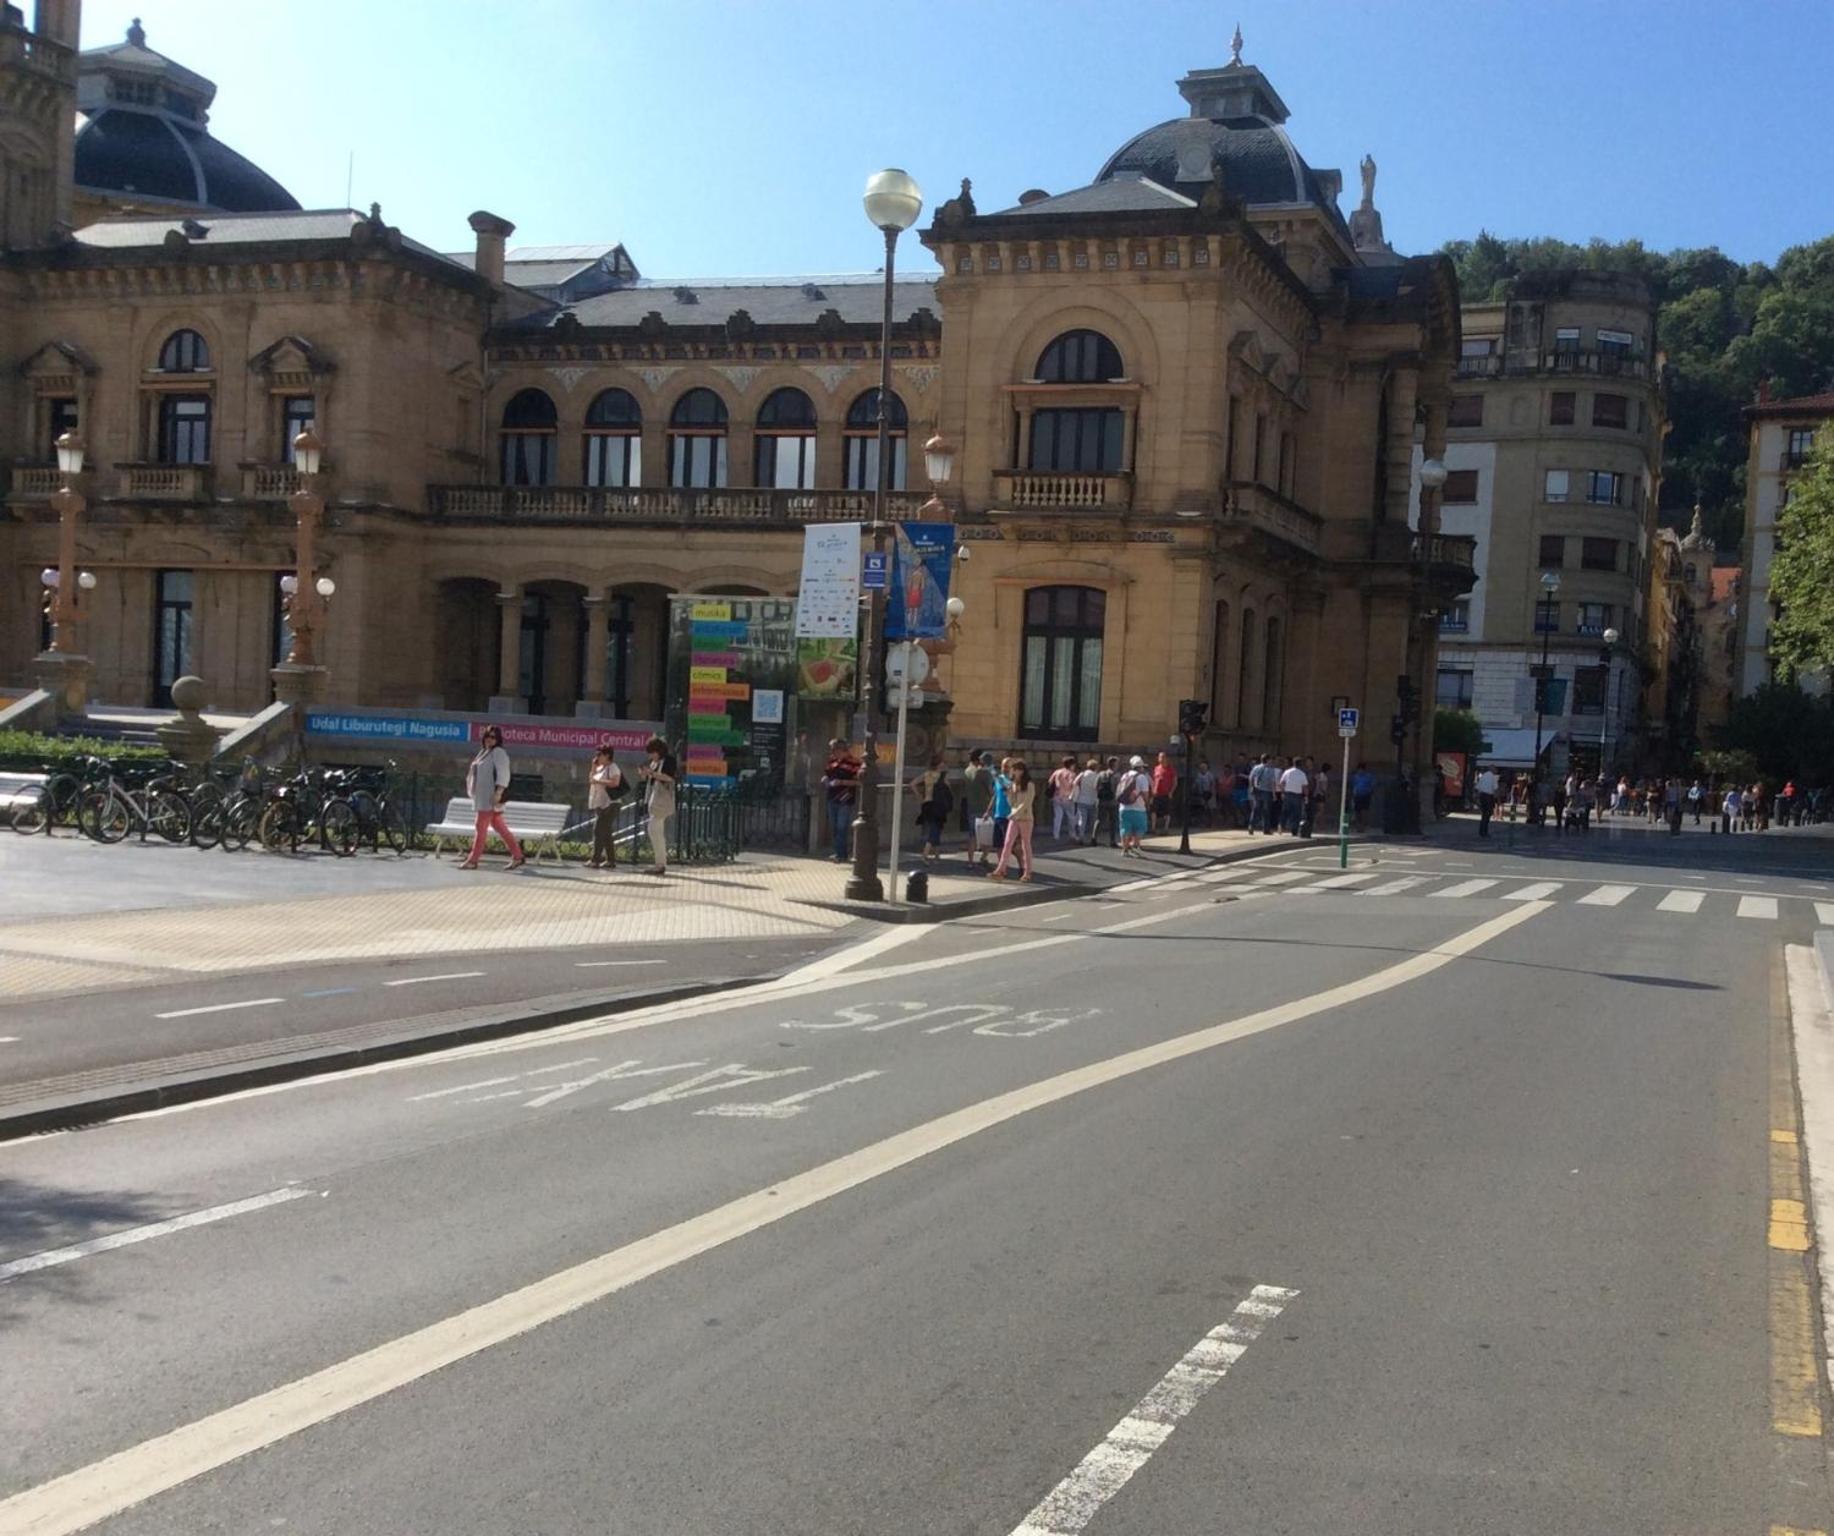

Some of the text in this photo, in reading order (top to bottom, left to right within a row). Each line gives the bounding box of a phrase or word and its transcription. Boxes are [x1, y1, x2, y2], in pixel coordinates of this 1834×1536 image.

[312, 717, 460, 737] Udal Liburutegi Nagusia
[539, 729, 597, 745] Municipal
[601, 732, 645, 747] Central
